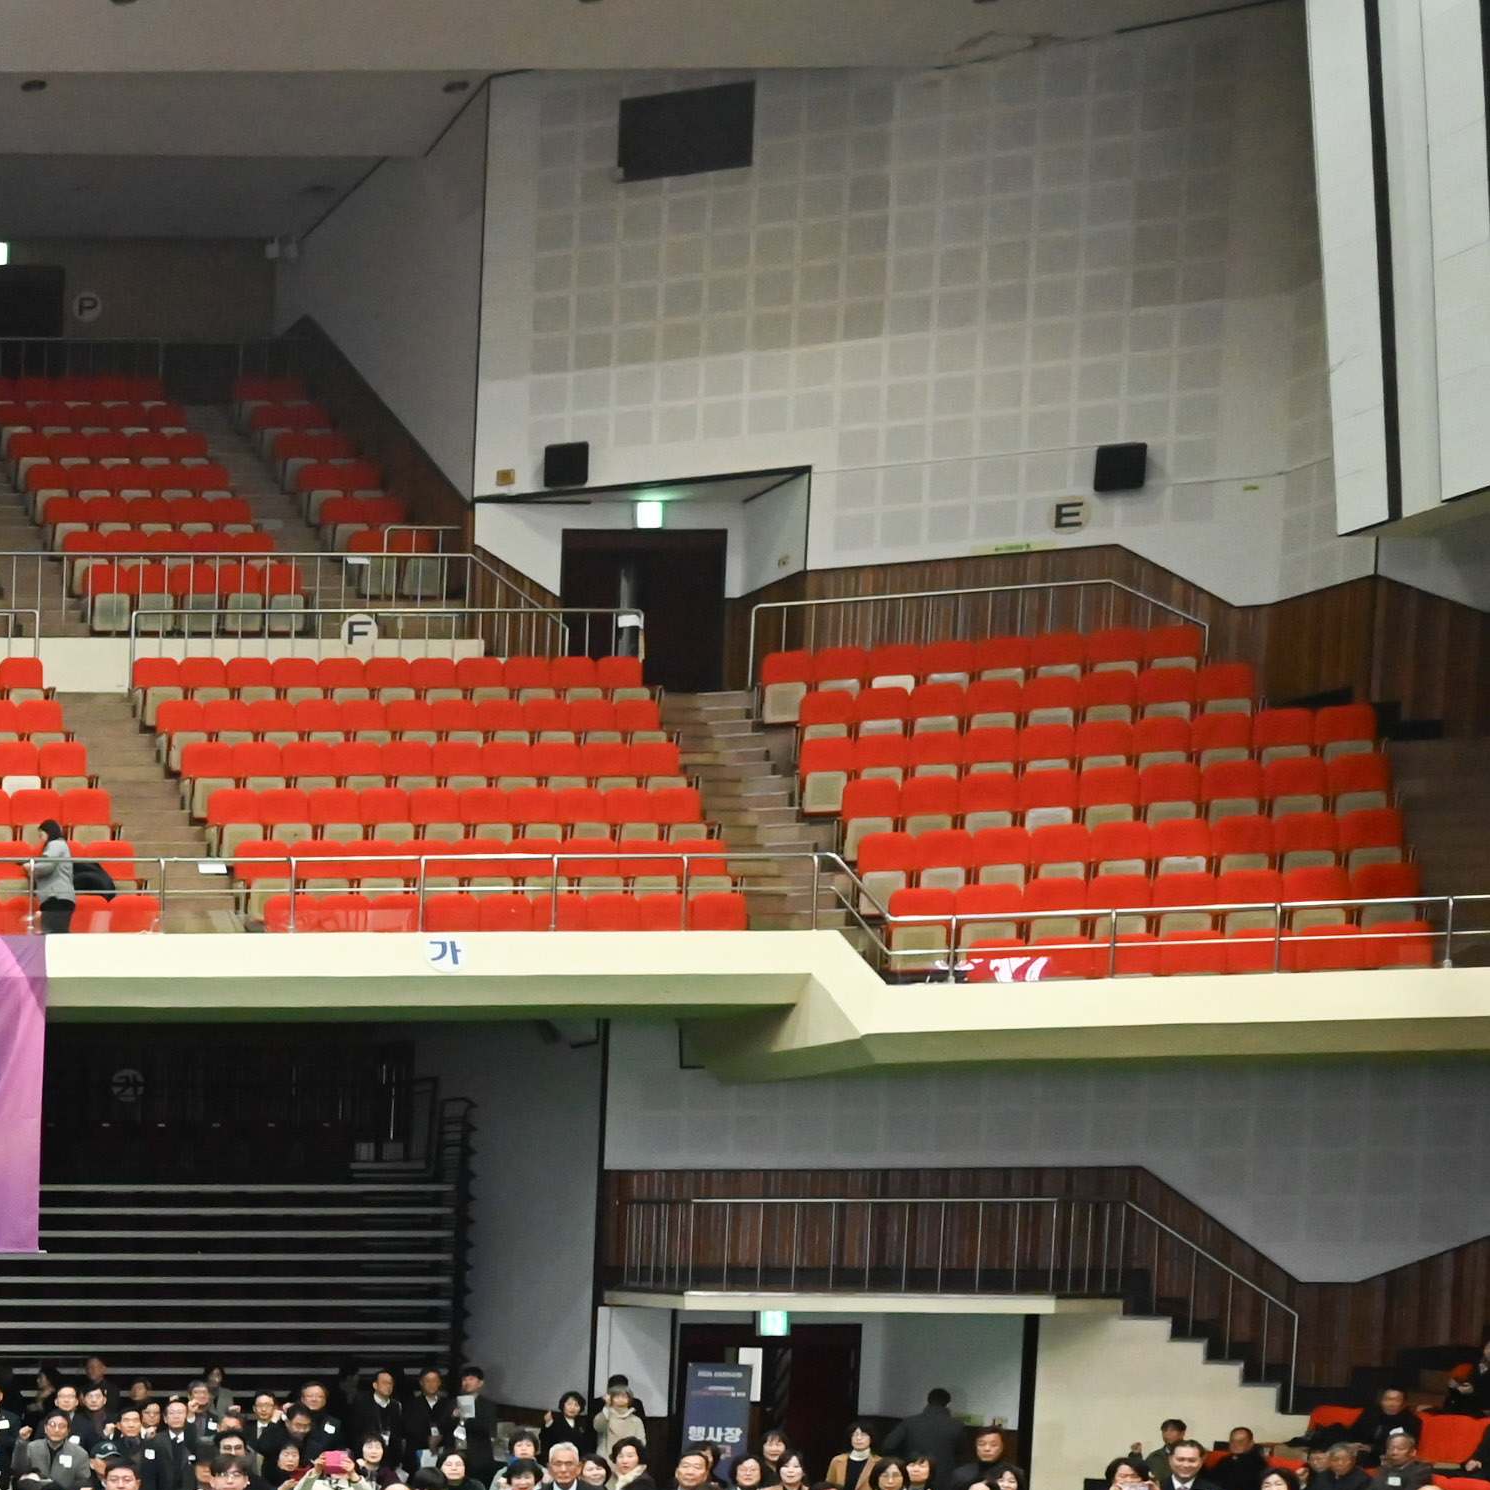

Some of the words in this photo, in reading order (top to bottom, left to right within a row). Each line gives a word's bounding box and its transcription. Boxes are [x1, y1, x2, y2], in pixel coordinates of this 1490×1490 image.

[79, 297, 97, 316] P
[1055, 502, 1083, 528] E
[348, 620, 373, 644] F
[429, 940, 462, 965] 가
[688, 1425, 743, 1443] 행사장
